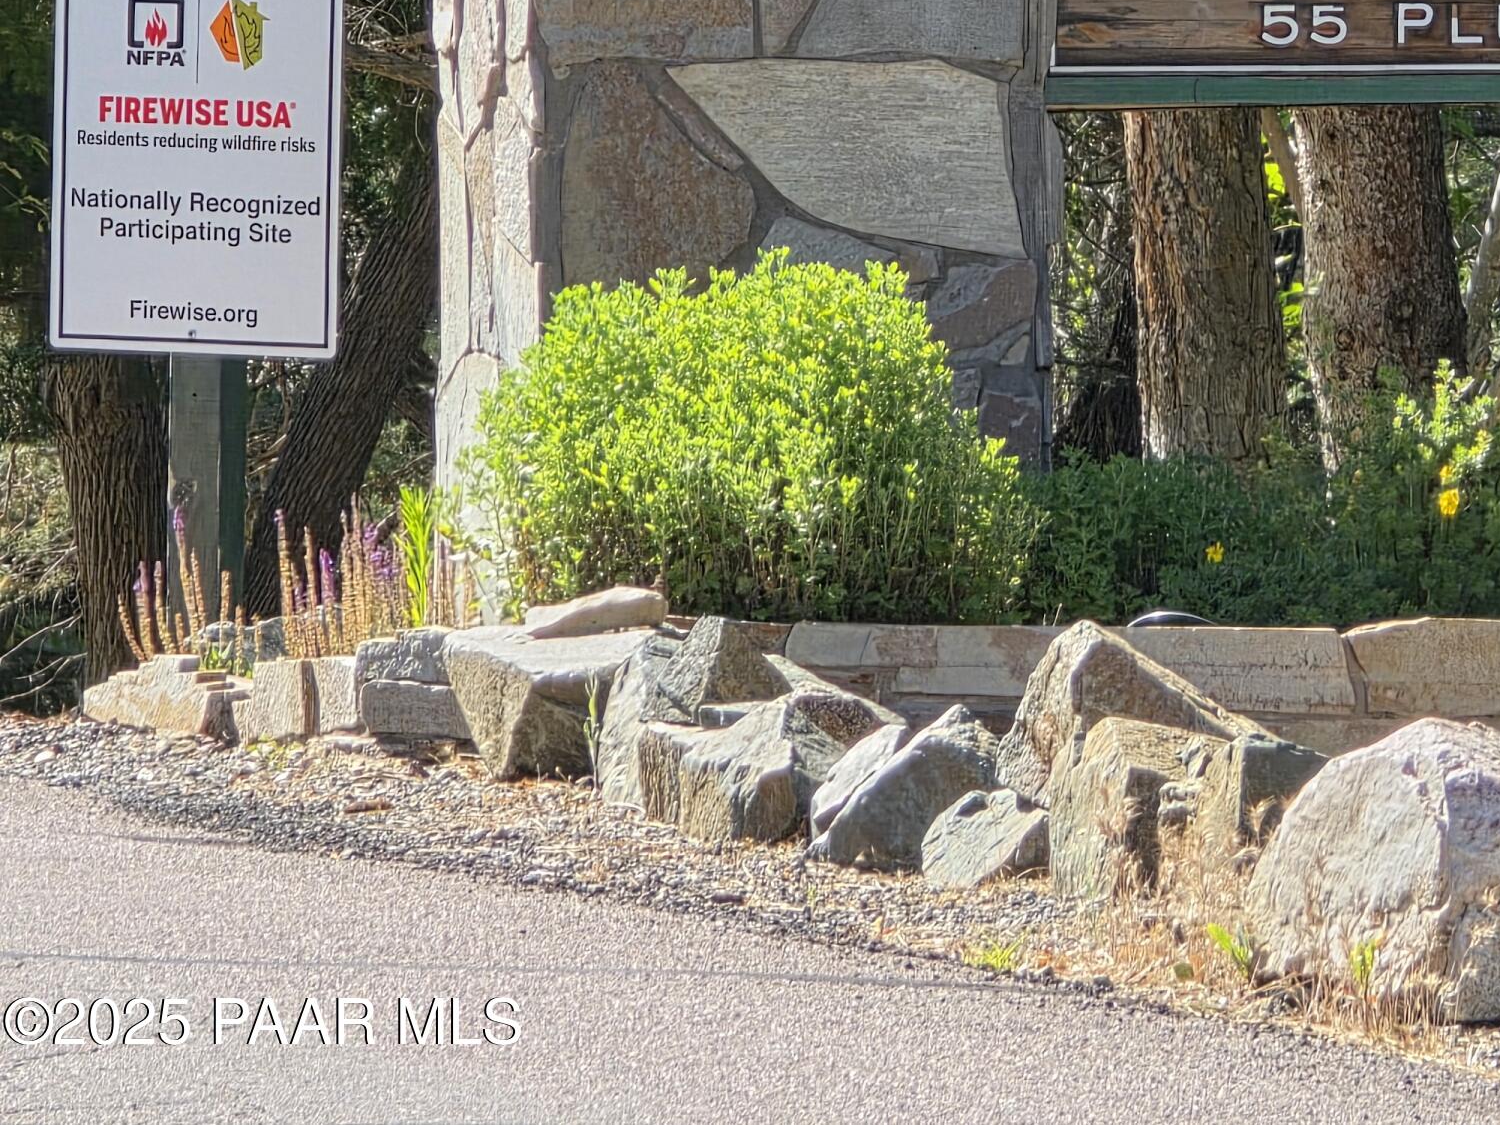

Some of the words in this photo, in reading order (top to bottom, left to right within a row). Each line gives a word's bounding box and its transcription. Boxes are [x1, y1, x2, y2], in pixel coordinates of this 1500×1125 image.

[1261, 3, 1348, 47] 55
[99, 95, 229, 126] FIREWISE
[76, 129, 149, 149] Residents
[153, 133, 218, 153] reducing
[221, 134, 277, 153] wildfire
[280, 137, 316, 154] risks
[71, 188, 182, 217] Nationally
[189, 192, 321, 219] Recognized
[99, 218, 241, 247] Participating
[248, 222, 293, 244] Site
[129, 300, 259, 328] Firewise.org
